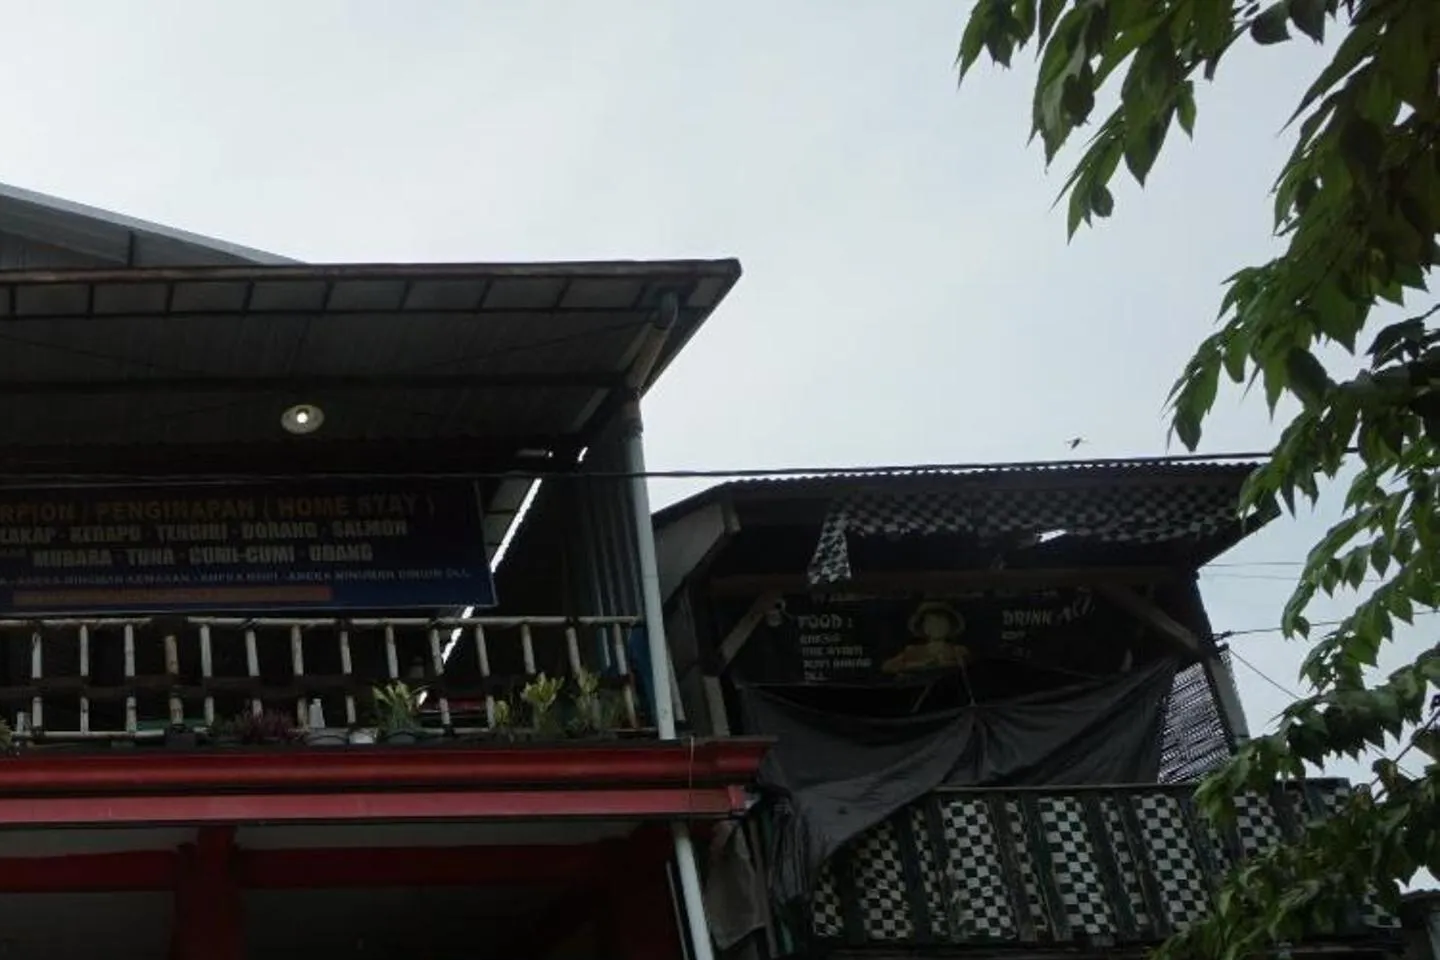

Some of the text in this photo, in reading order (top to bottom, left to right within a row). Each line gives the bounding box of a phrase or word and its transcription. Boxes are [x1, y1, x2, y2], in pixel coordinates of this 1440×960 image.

[97, 498, 255, 521] PENGINAPAN
[276, 496, 350, 517] HOME
[331, 518, 409, 537] SALMON
[126, 547, 176, 566] TUNA
[797, 614, 843, 629] FOOD
[1001, 607, 1053, 626] DRINK
